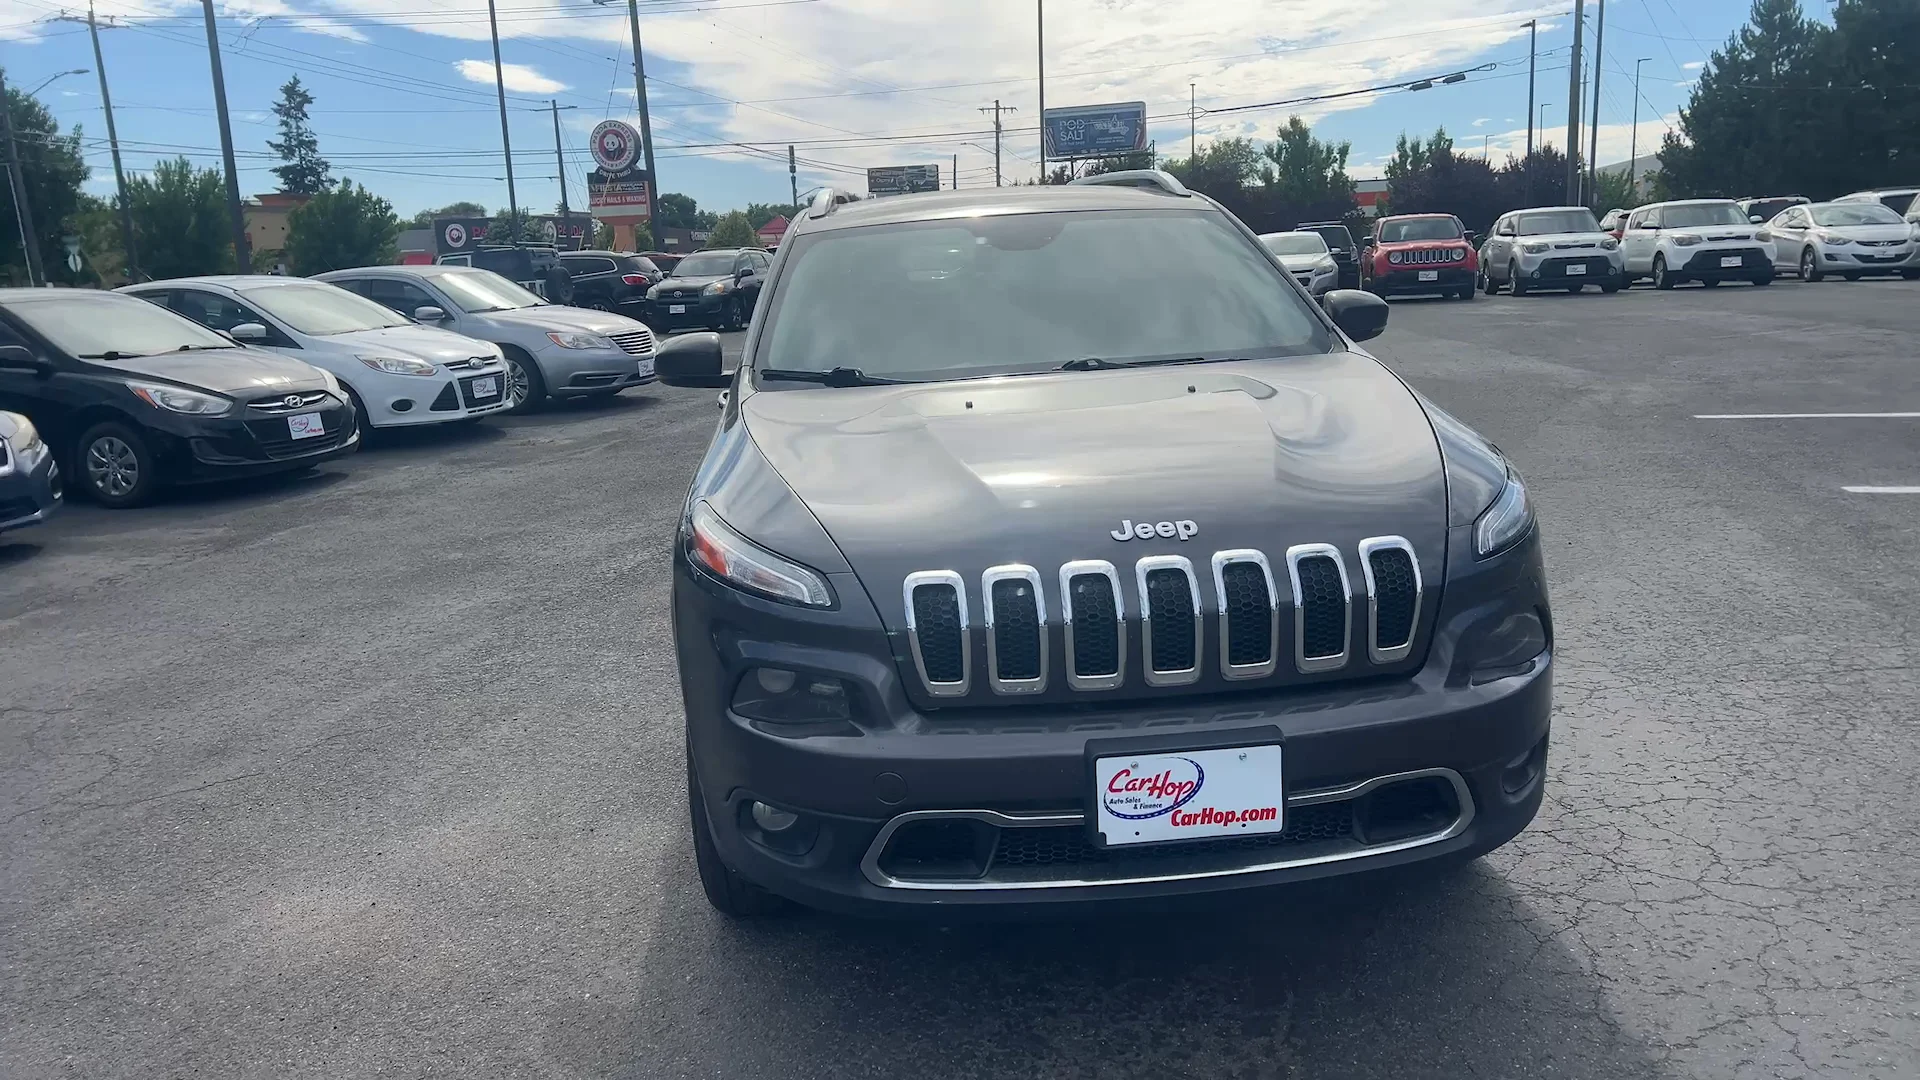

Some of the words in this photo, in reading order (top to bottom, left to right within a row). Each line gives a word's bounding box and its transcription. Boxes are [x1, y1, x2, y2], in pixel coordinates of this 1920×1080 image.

[1060, 119, 1085, 130] POD
[592, 124, 608, 144] PANDA
[608, 122, 633, 143] EXPRESS
[1060, 130, 1085, 141] SALT
[557, 224, 584, 236] PADA
[1110, 519, 1199, 541] Jeep
[1108, 768, 1195, 805] CarHop
[1109, 797, 1124, 805] Auto
[1124, 796, 1141, 804] Sales
[1171, 807, 1277, 827] CarHop.com
